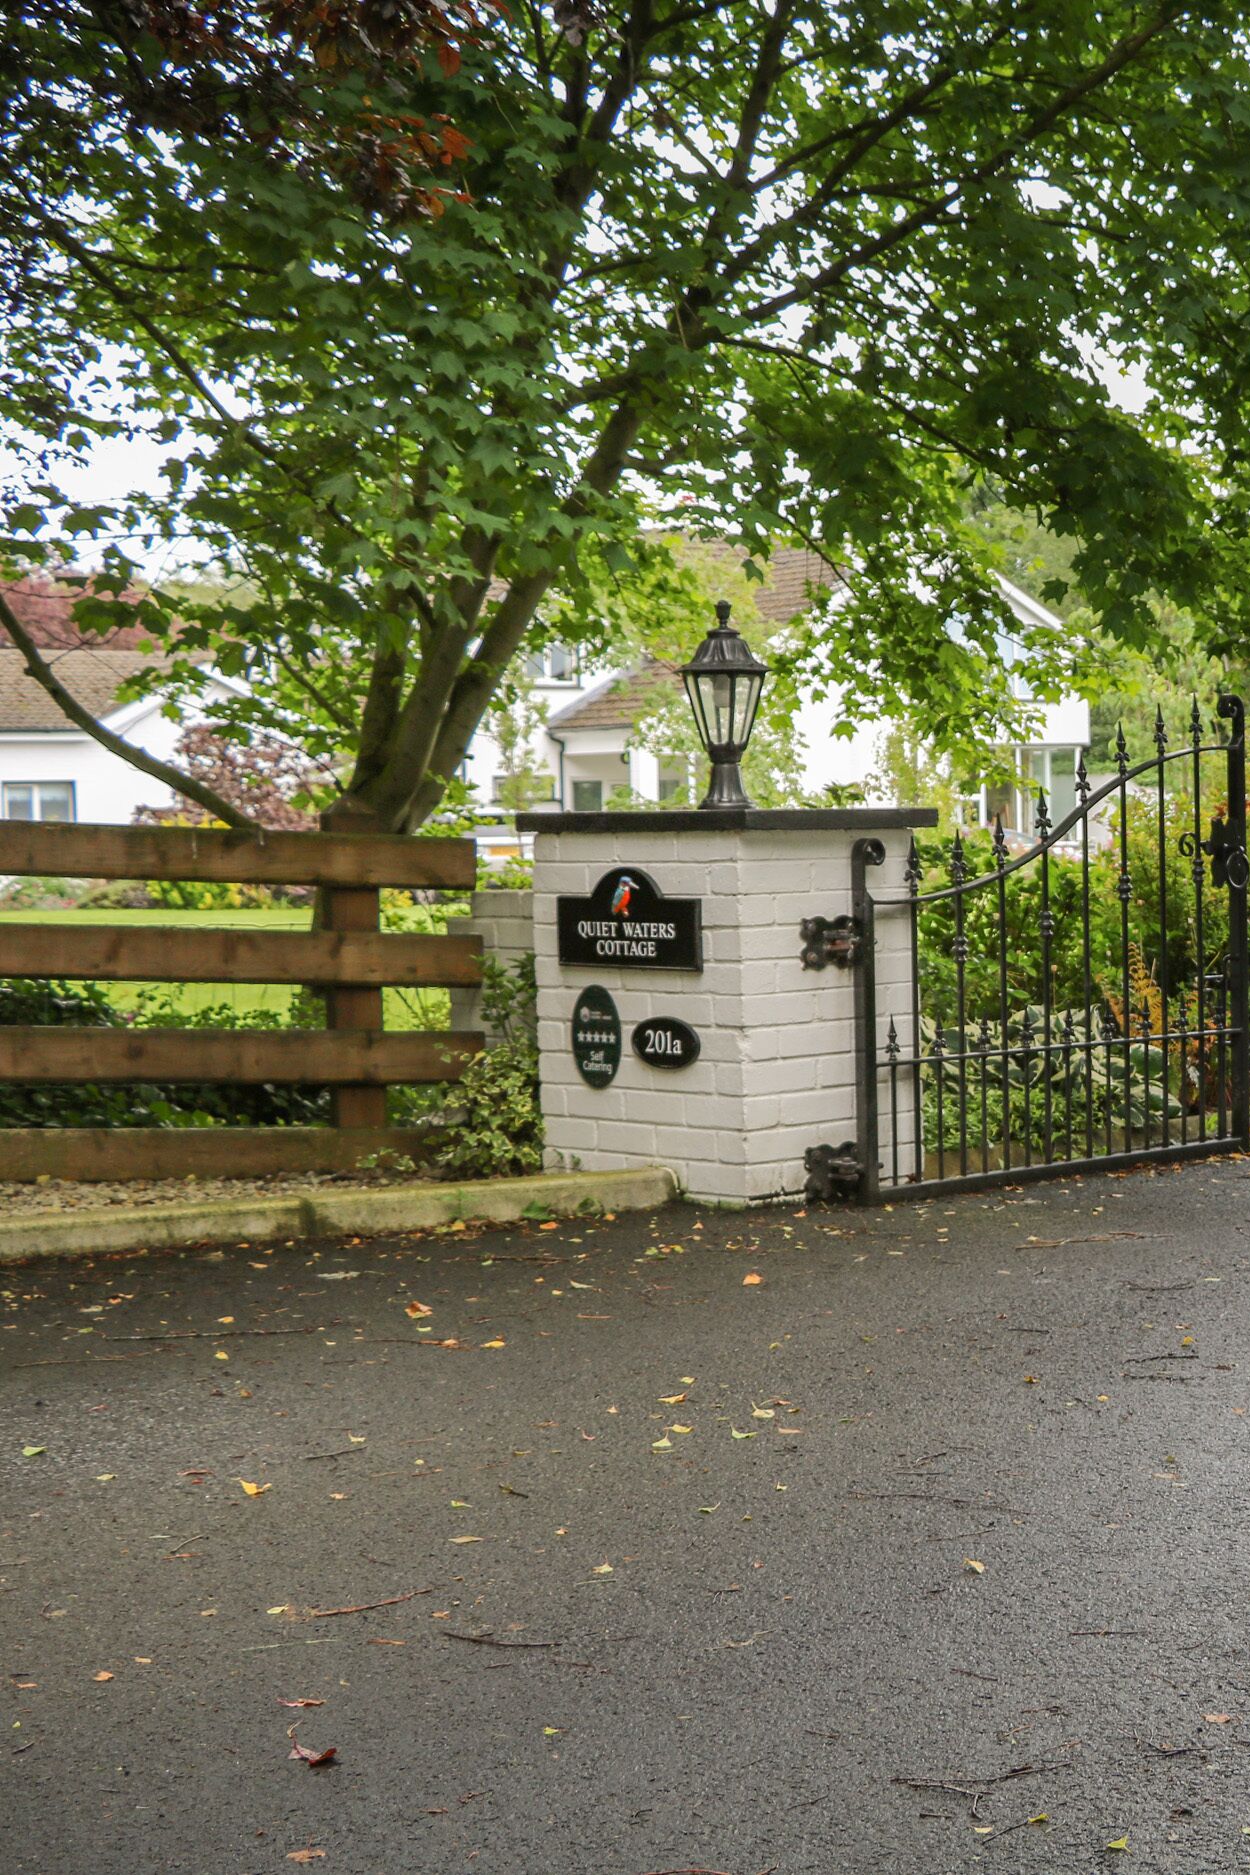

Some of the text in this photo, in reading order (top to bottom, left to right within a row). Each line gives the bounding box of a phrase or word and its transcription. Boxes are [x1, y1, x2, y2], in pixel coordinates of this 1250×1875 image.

[577, 920, 676, 939] QUIET WATERS
[596, 939, 657, 957] COTTAGE
[644, 1029, 682, 1054] 201a
[590, 1050, 605, 1062] Self
[582, 1060, 613, 1074] Catering
